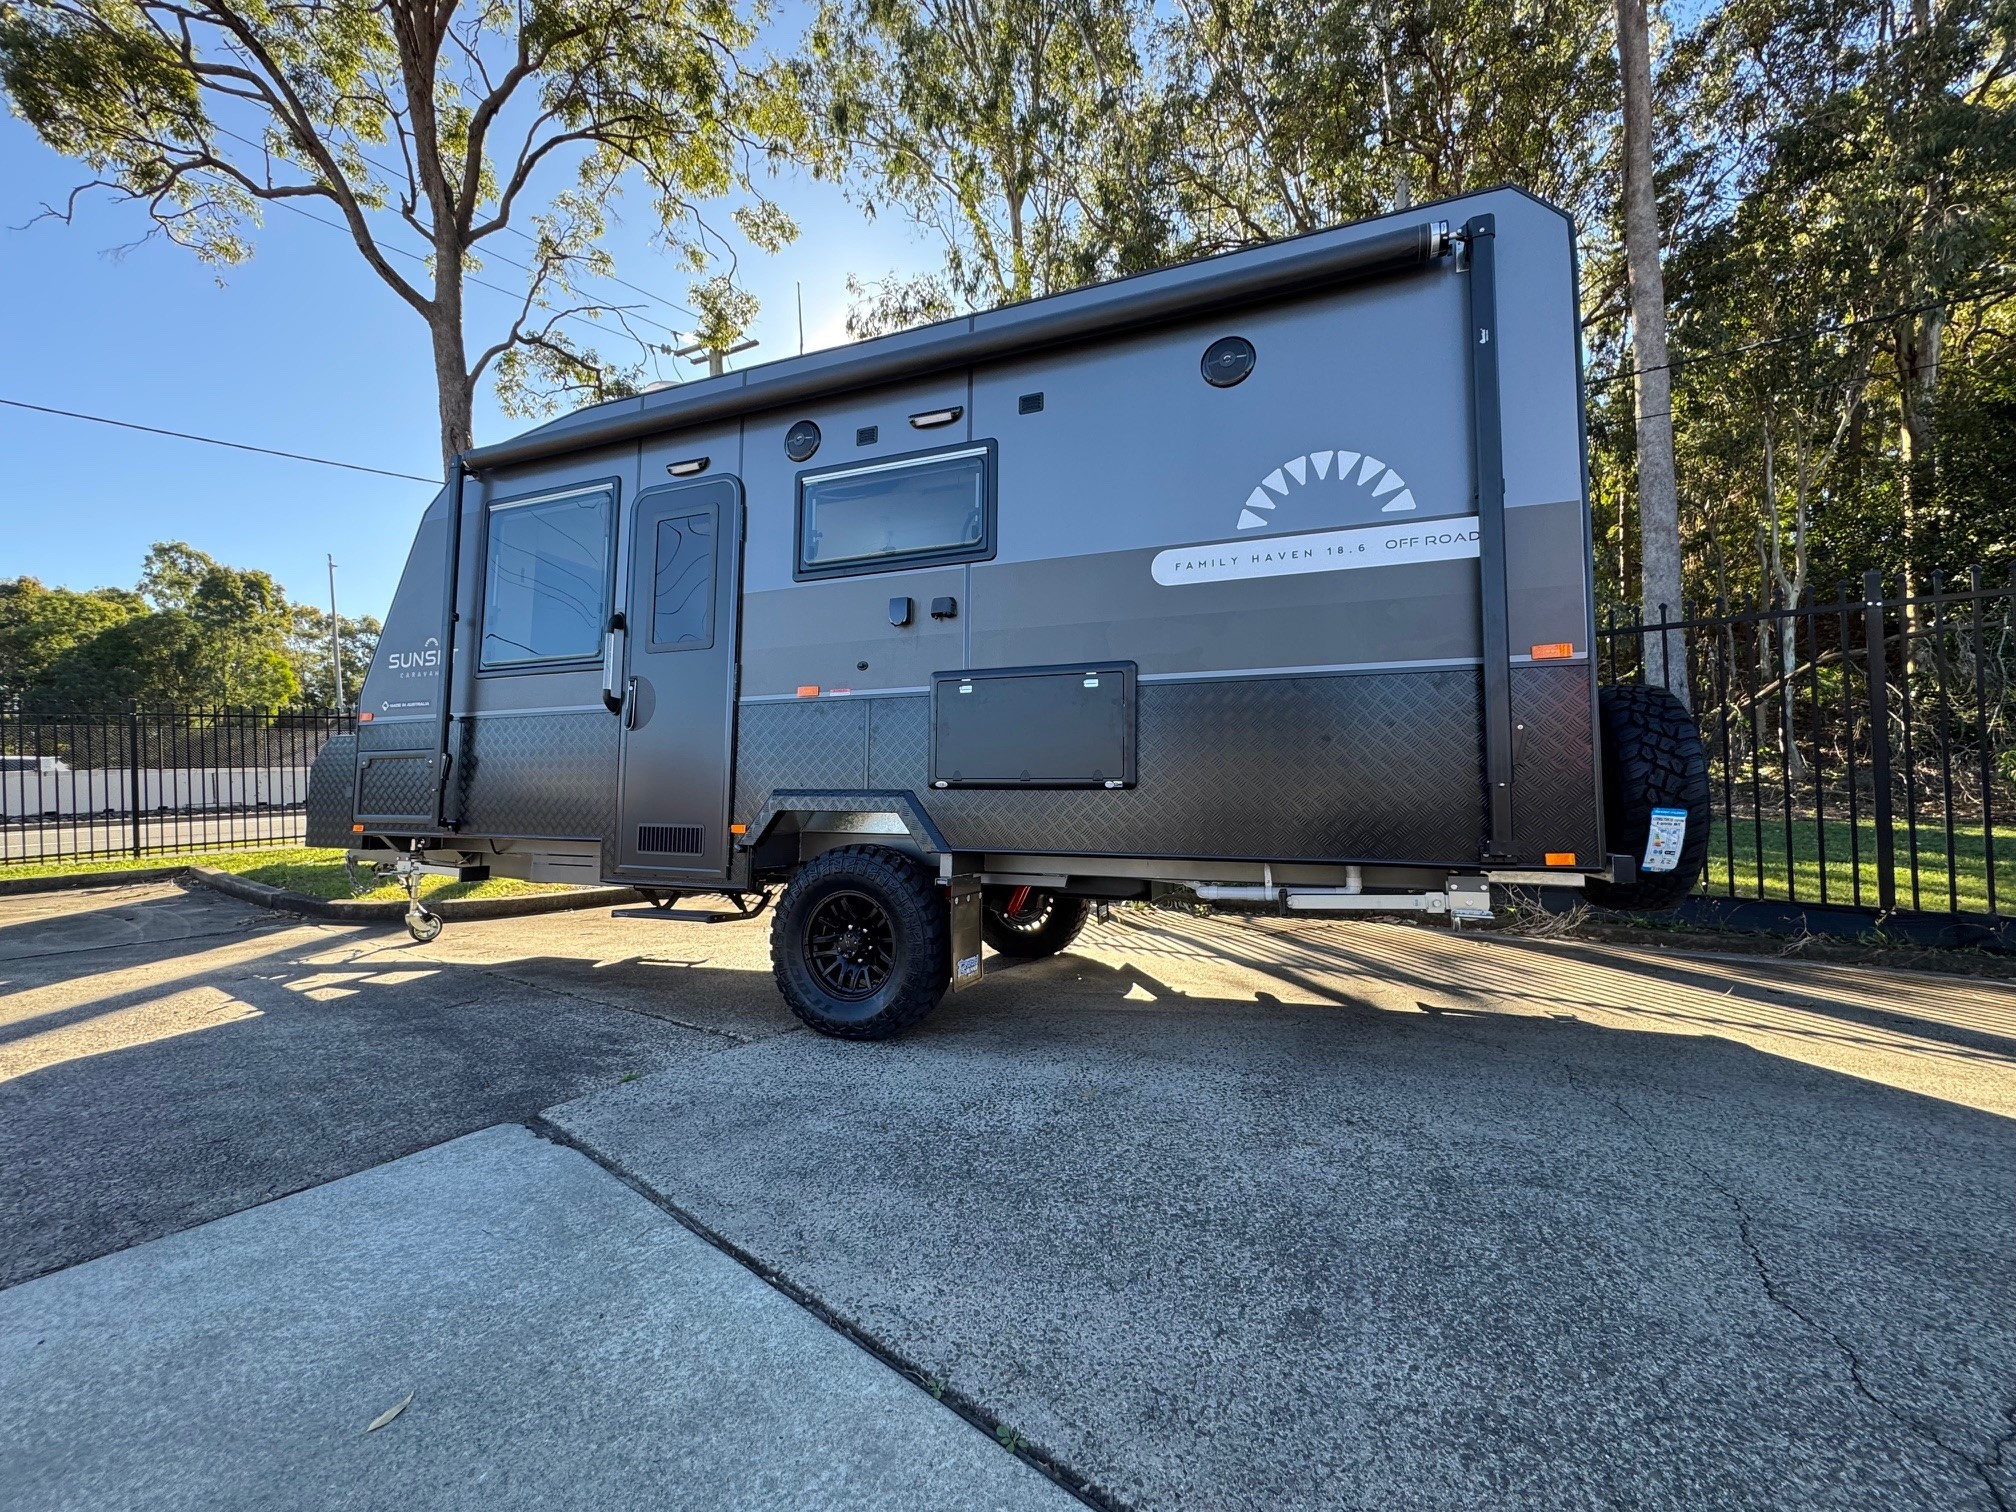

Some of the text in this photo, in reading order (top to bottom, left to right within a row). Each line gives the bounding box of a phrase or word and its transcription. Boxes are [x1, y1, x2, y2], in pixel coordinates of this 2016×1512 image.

[1174, 530, 1481, 572] FAMILY HAVEN 18.6 OFF ROAD
